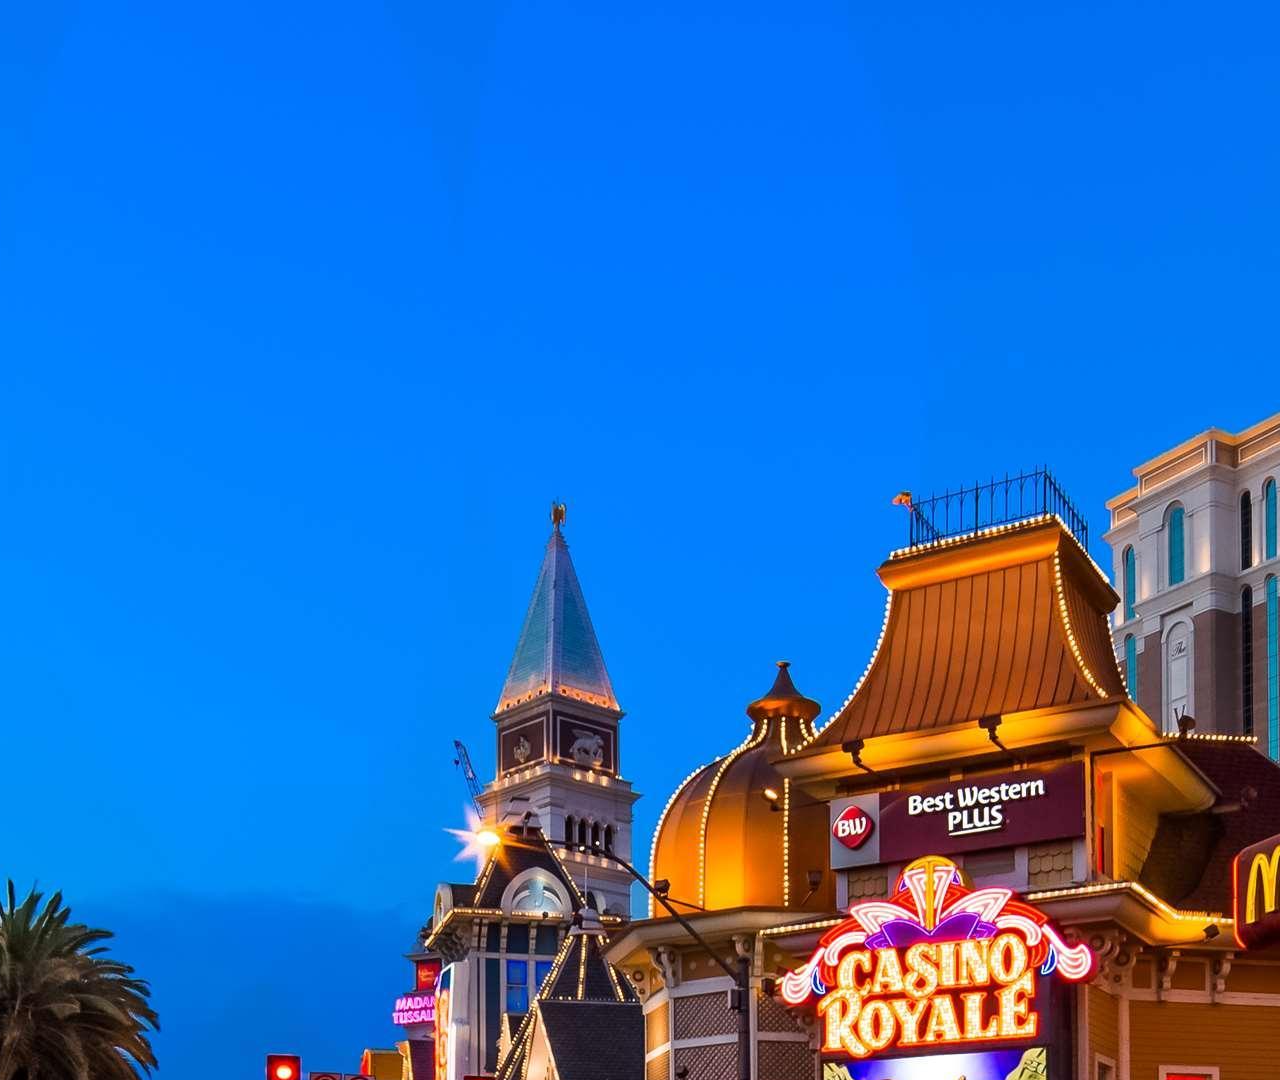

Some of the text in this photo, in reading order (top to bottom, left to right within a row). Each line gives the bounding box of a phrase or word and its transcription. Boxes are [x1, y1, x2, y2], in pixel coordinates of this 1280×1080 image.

[908, 779, 1045, 815] Best Western
[837, 816, 867, 837] BW
[948, 805, 1003, 831] PLUS
[836, 934, 1028, 999] CASINO
[818, 969, 1038, 1058] ROYALE
